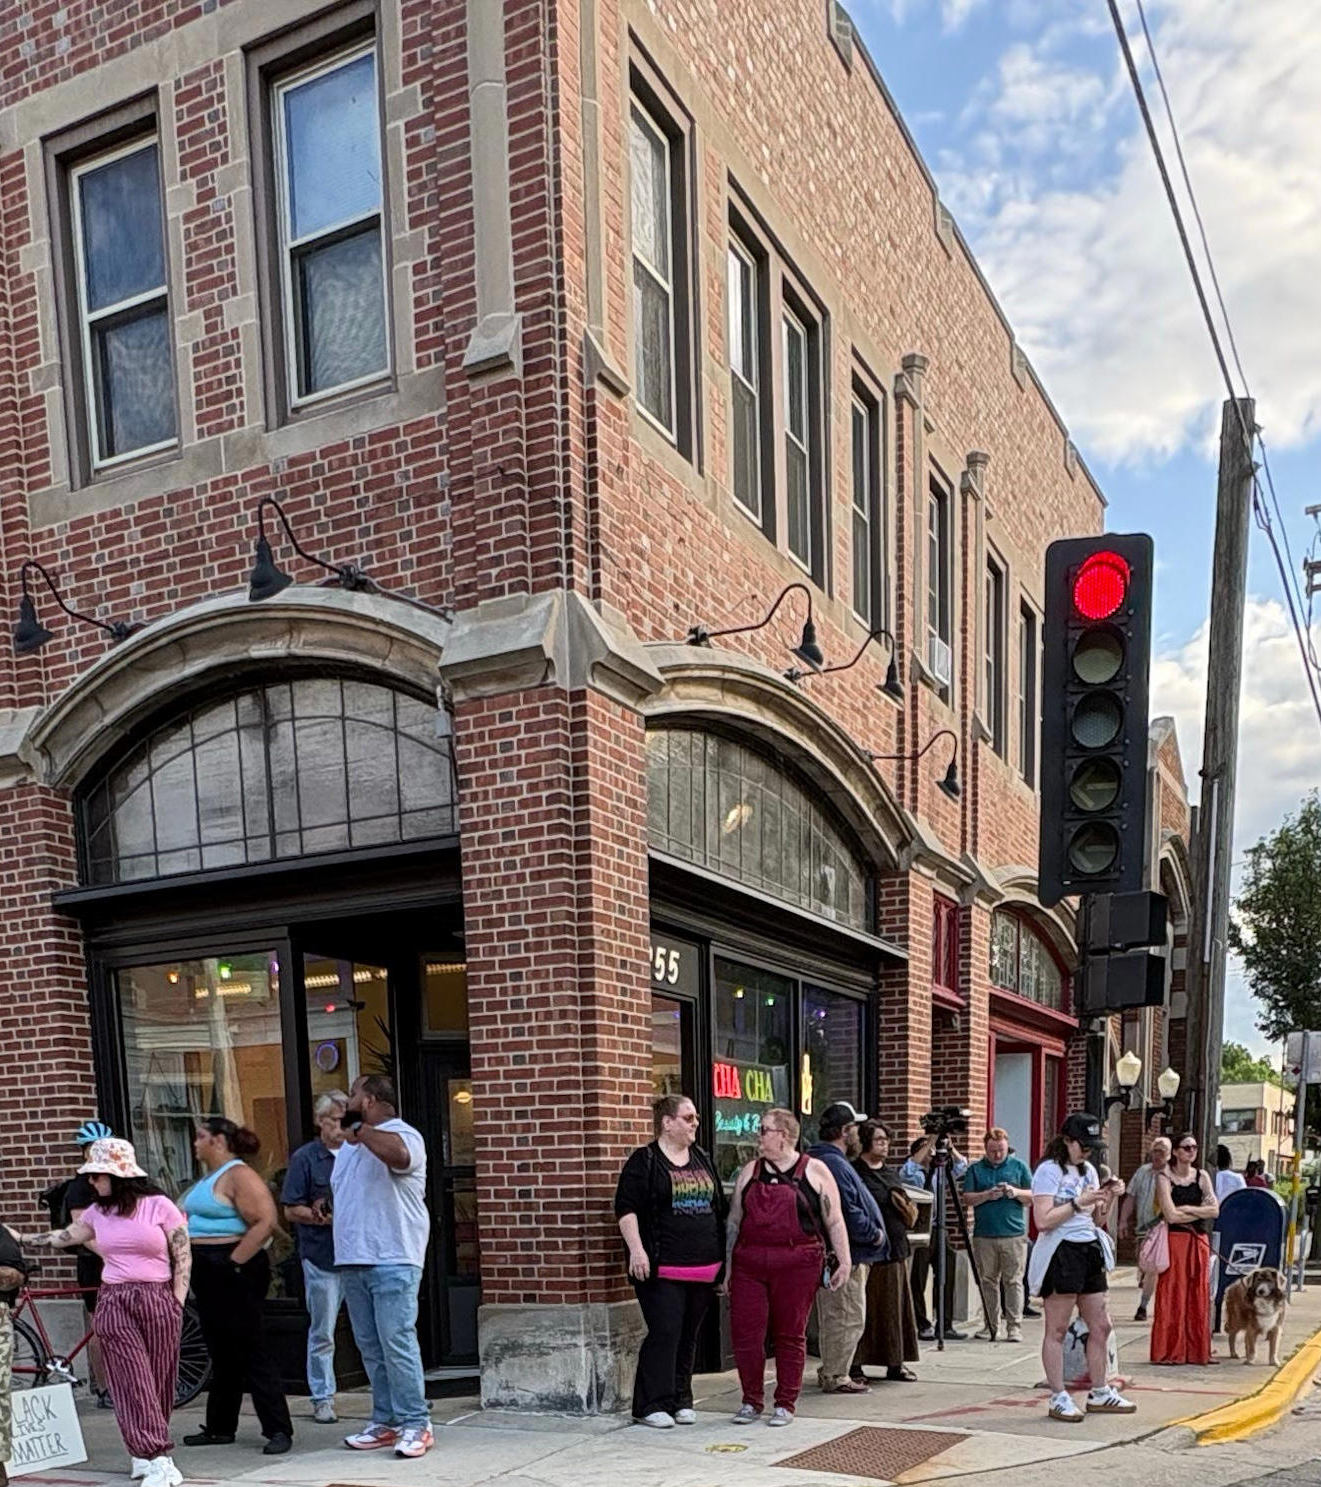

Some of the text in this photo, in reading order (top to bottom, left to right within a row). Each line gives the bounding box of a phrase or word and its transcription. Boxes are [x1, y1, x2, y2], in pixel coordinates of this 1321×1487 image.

[649, 946, 680, 985] 55
[713, 1063, 775, 1104] CHA CHA
[11, 1394, 58, 1425] LACK
[11, 1432, 69, 1464] MATTER
